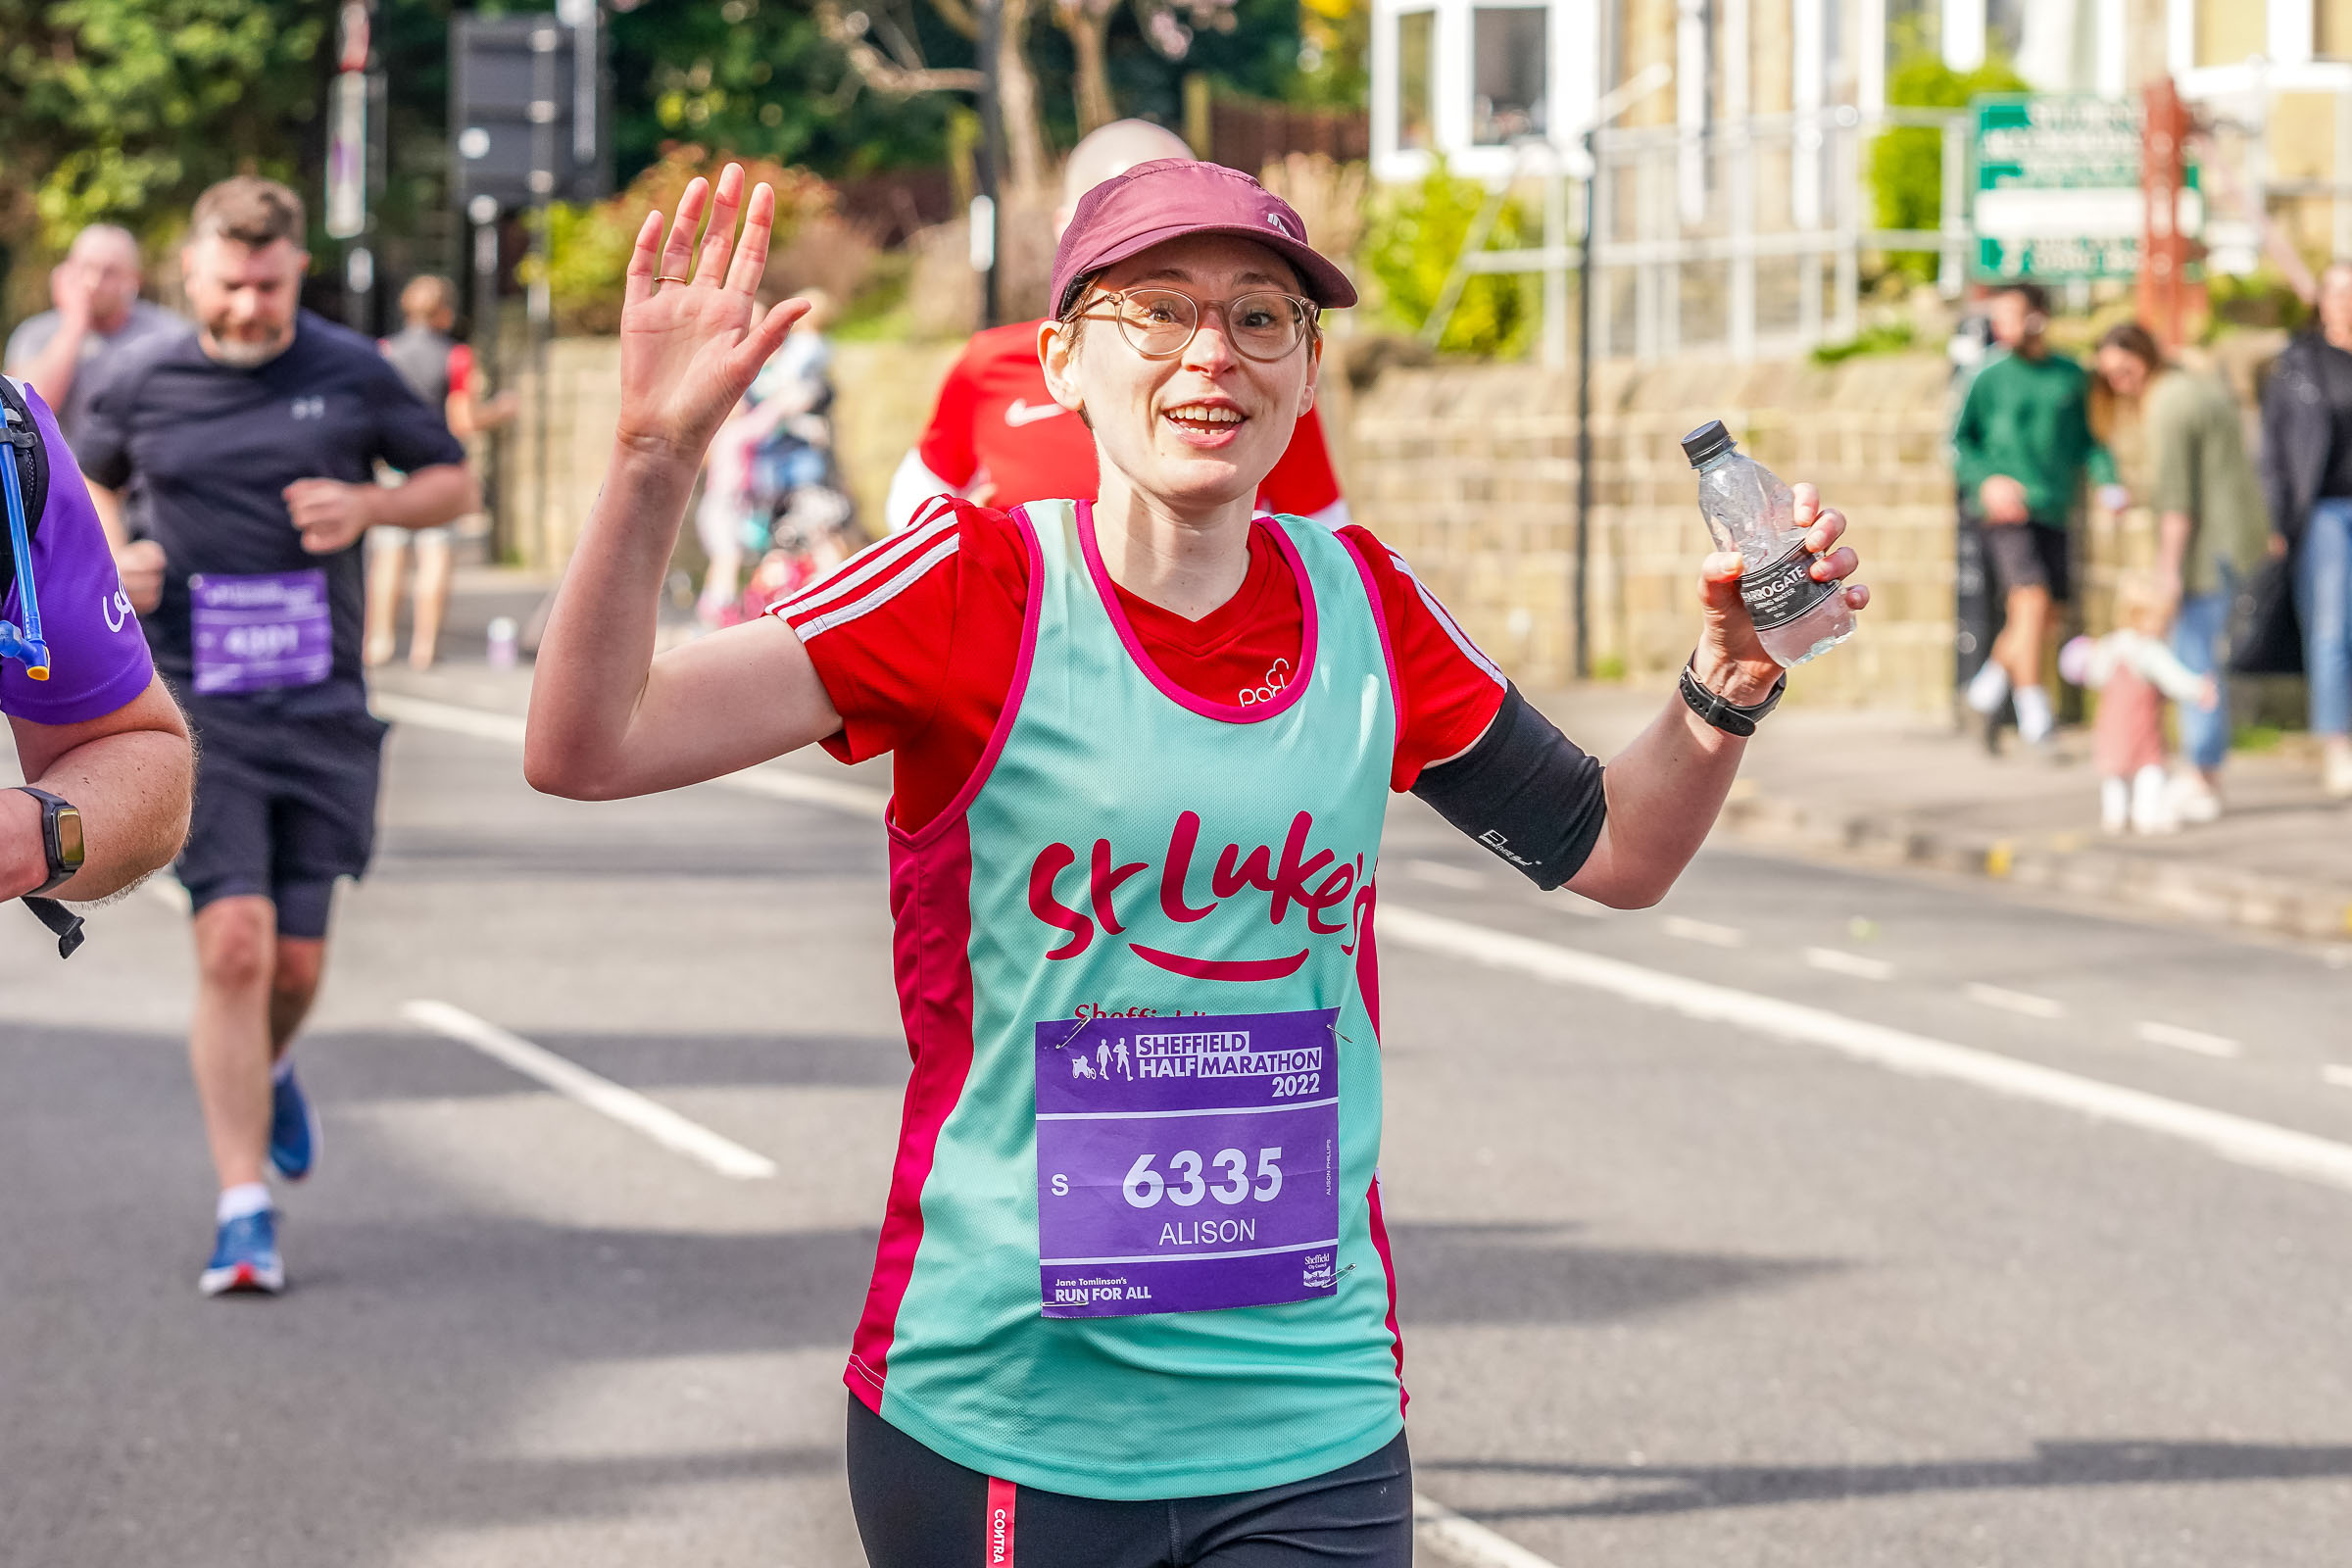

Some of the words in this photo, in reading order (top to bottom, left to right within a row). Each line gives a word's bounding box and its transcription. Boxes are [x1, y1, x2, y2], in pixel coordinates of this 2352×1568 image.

[1139, 1033, 1247, 1055] SHEFFIELD
[1271, 1073, 1320, 1098] 2022
[1051, 1173, 1069, 1197] S
[1122, 1147, 1283, 1208] 6335
[1158, 1218, 1255, 1246] ALISON
[1055, 1278, 1077, 1287] Jane
[1078, 1276, 1128, 1286] Tomlinson's
[1055, 1288, 1089, 1301] RUN
[1092, 1287, 1122, 1300] FOR
[1125, 1286, 1152, 1300] ALL
[994, 1508, 1005, 1564] CONTRA
